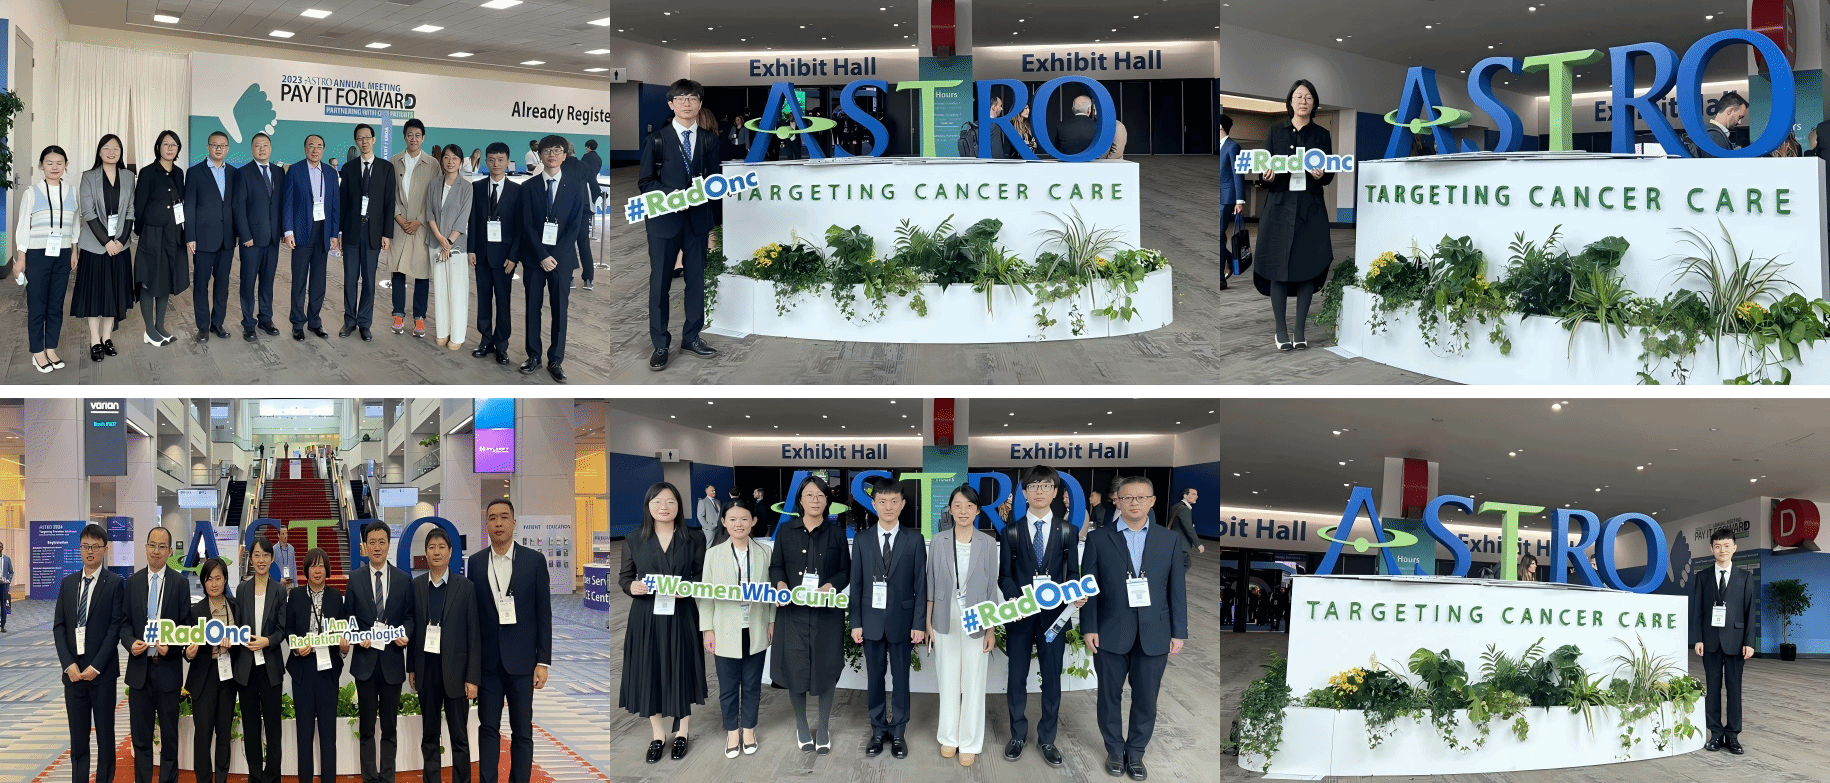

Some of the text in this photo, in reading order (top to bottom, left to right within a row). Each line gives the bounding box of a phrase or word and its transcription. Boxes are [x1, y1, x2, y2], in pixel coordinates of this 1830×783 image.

[749, 56, 876, 77] Exhibit Hall
[1022, 49, 1162, 73] Exhibit Hall
[281, 74, 303, 84] 2023
[333, 79, 367, 90] ANNUAL
[367, 82, 401, 92] MEETING
[1383, 28, 1797, 158] ASTRO
[280, 83, 417, 110] PAY IT FORWARD
[511, 100, 611, 126] Already Registe
[743, 74, 1117, 163] ASTRO
[1236, 148, 1353, 172] #RadOnc
[627, 171, 758, 222] #RadOnc
[915, 183, 1029, 201] CANCER
[1048, 183, 1124, 201] CARE
[1364, 184, 1792, 216] TARGETING CANCER CARE
[781, 443, 888, 461] Exhibit Hall
[1010, 441, 1129, 461] Exhibit Hall
[1255, 519, 1307, 542] Hall
[1780, 508, 1797, 537] D
[1315, 485, 1669, 594] ASTRO
[1458, 533, 1531, 555] Exhiit
[1694, 530, 1706, 541] PAY
[1397, 555, 1420, 564] Hours
[643, 575, 848, 608] #WomenWhoCurie
[962, 576, 1097, 633] #RadOnc
[1306, 600, 1678, 630] TARGETING CANCER CARE
[145, 619, 250, 645] #RadOnc
[329, 619, 347, 631] Am
[349, 618, 358, 630] A
